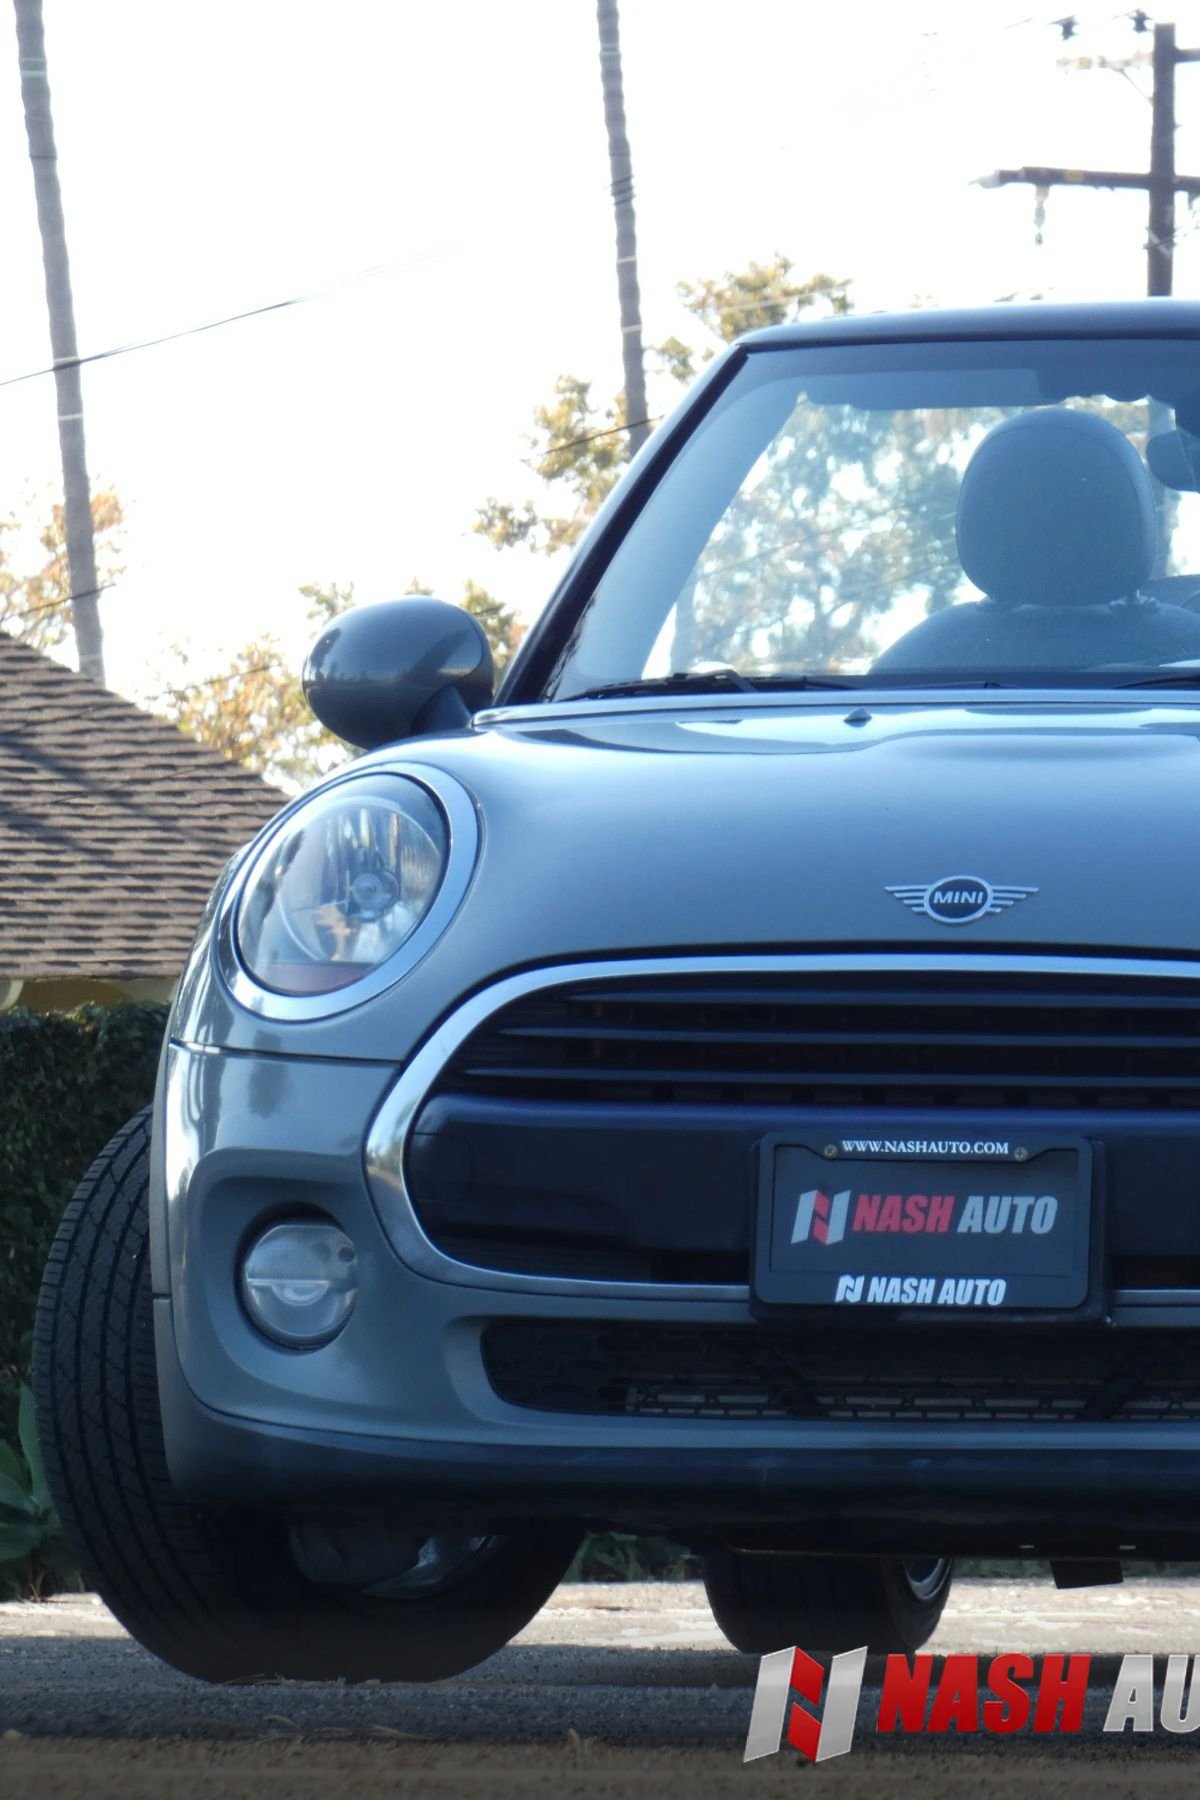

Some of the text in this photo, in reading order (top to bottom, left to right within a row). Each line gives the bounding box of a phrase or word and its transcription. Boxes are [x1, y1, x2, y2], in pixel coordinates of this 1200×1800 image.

[933, 891, 984, 904] MINI
[842, 1139, 1009, 1155] WWW.NASHAUTO.COM
[853, 1194, 955, 1233] NASH
[957, 1196, 1058, 1234] AUTO
[868, 1276, 937, 1304] NASH
[938, 1278, 1007, 1305] AUTO
